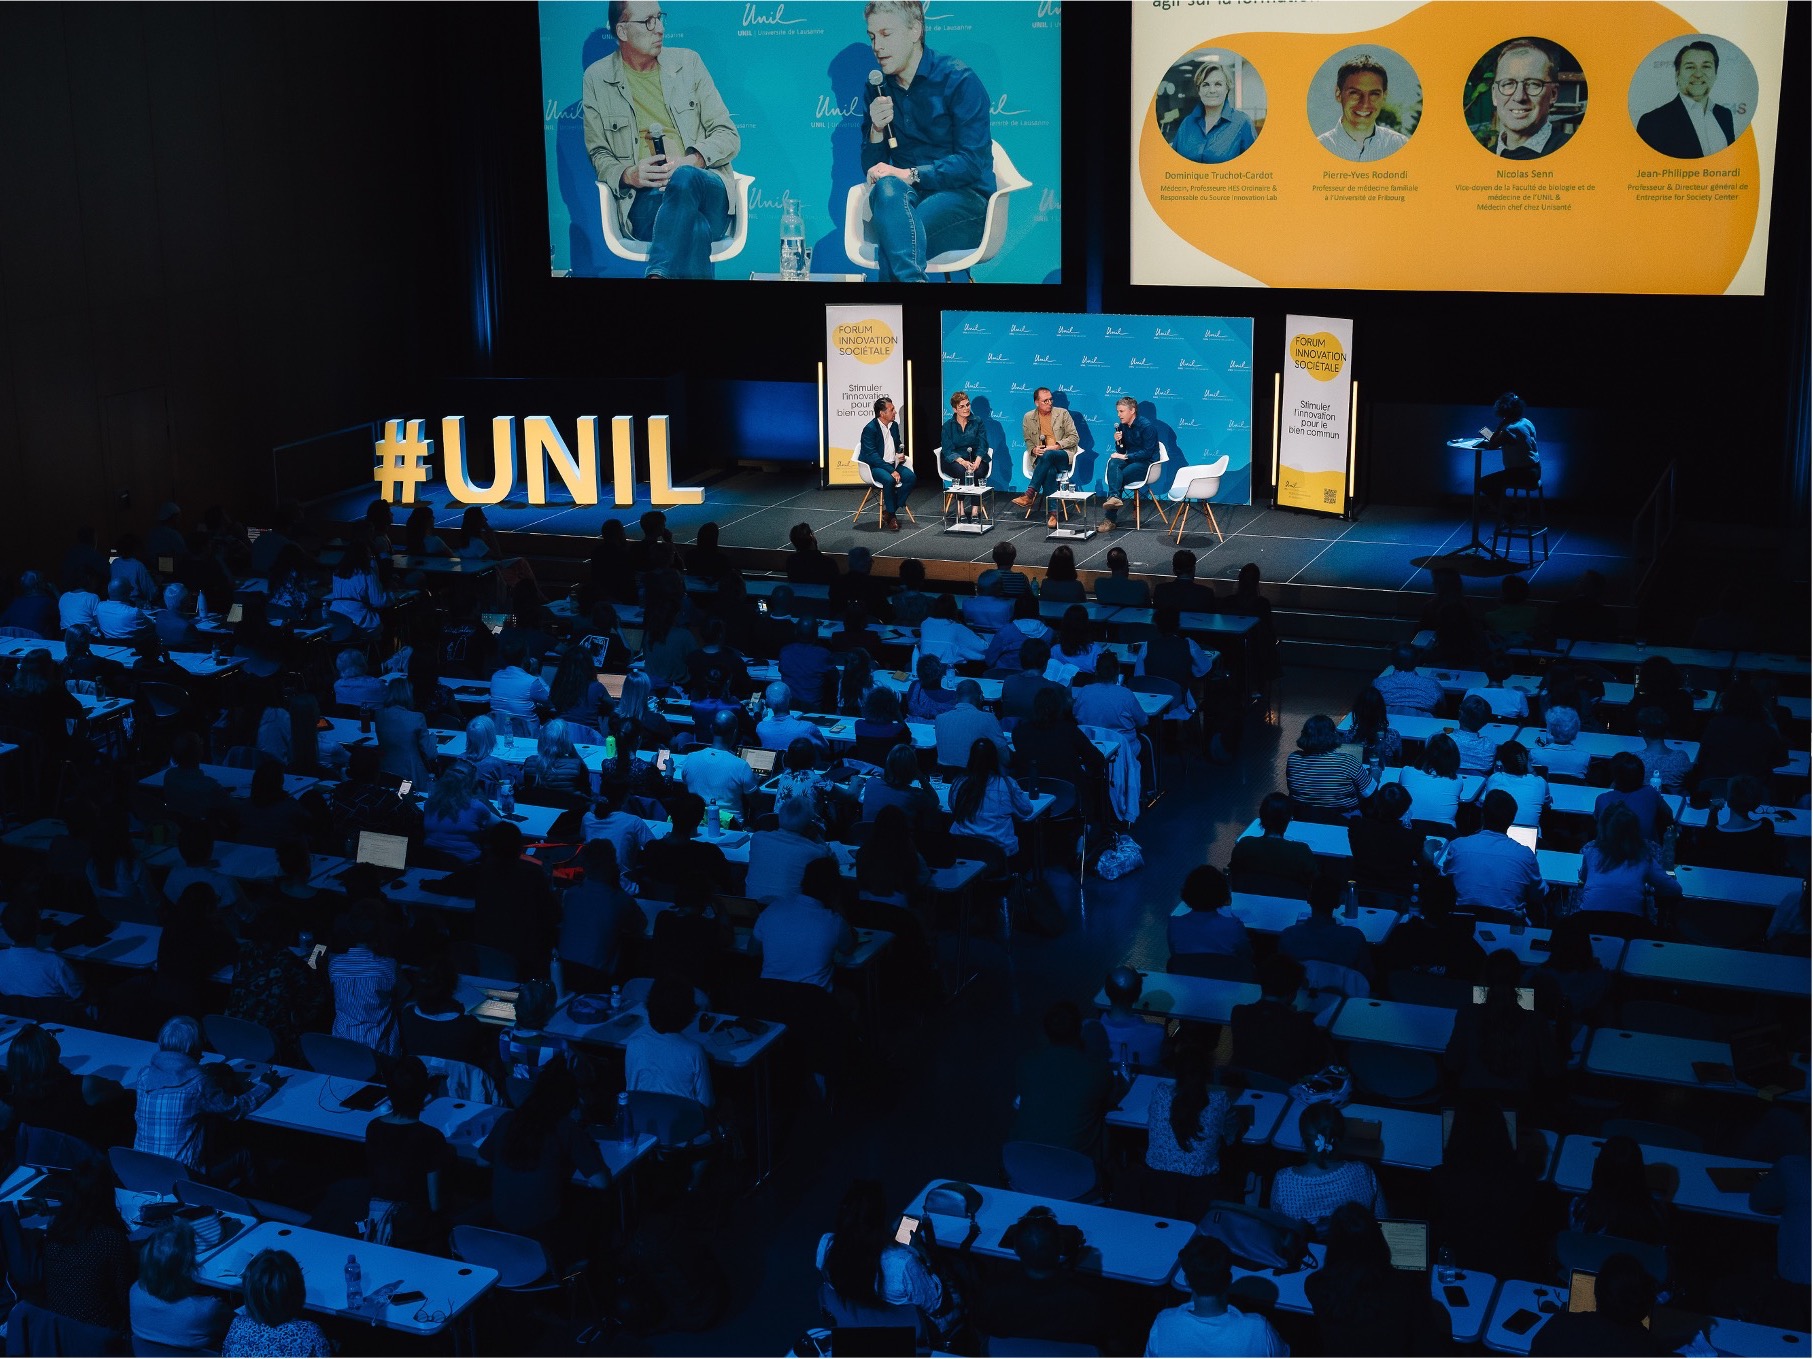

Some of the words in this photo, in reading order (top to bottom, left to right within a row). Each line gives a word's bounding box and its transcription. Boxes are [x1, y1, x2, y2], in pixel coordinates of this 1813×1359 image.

[743, 3, 807, 26] Unil
[815, 95, 863, 118] Unil
[1165, 172, 1209, 181] Dominique
[1212, 171, 1273, 180] Truchot-Cardot
[1323, 171, 1369, 179] Pierre-Yves
[1372, 171, 1408, 179] Rodondi
[1497, 170, 1528, 178] Nicolas
[1531, 170, 1553, 178] Senn
[1636, 169, 1699, 179] Jean-Philippe
[1703, 168, 1740, 177] Bonardi
[1549, 184, 1576, 192] biologie
[839, 325, 872, 334] FORUM
[839, 336, 898, 345] INNOVATION
[1295, 337, 1325, 347] FORUM
[839, 346, 890, 355] SOCIÉTALE
[1295, 349, 1346, 361] INNOVATION
[1295, 360, 1339, 372] SOCIÉTALE
[849, 384, 882, 392] Stimuler
[851, 401, 871, 409] pour
[1300, 401, 1330, 411] Stimuler
[857, 409, 874, 417] com
[1301, 419, 1319, 427] pour
[1288, 426, 1304, 435] bien
[1307, 429, 1340, 439] commun
[374, 415, 705, 505] #UNIL
